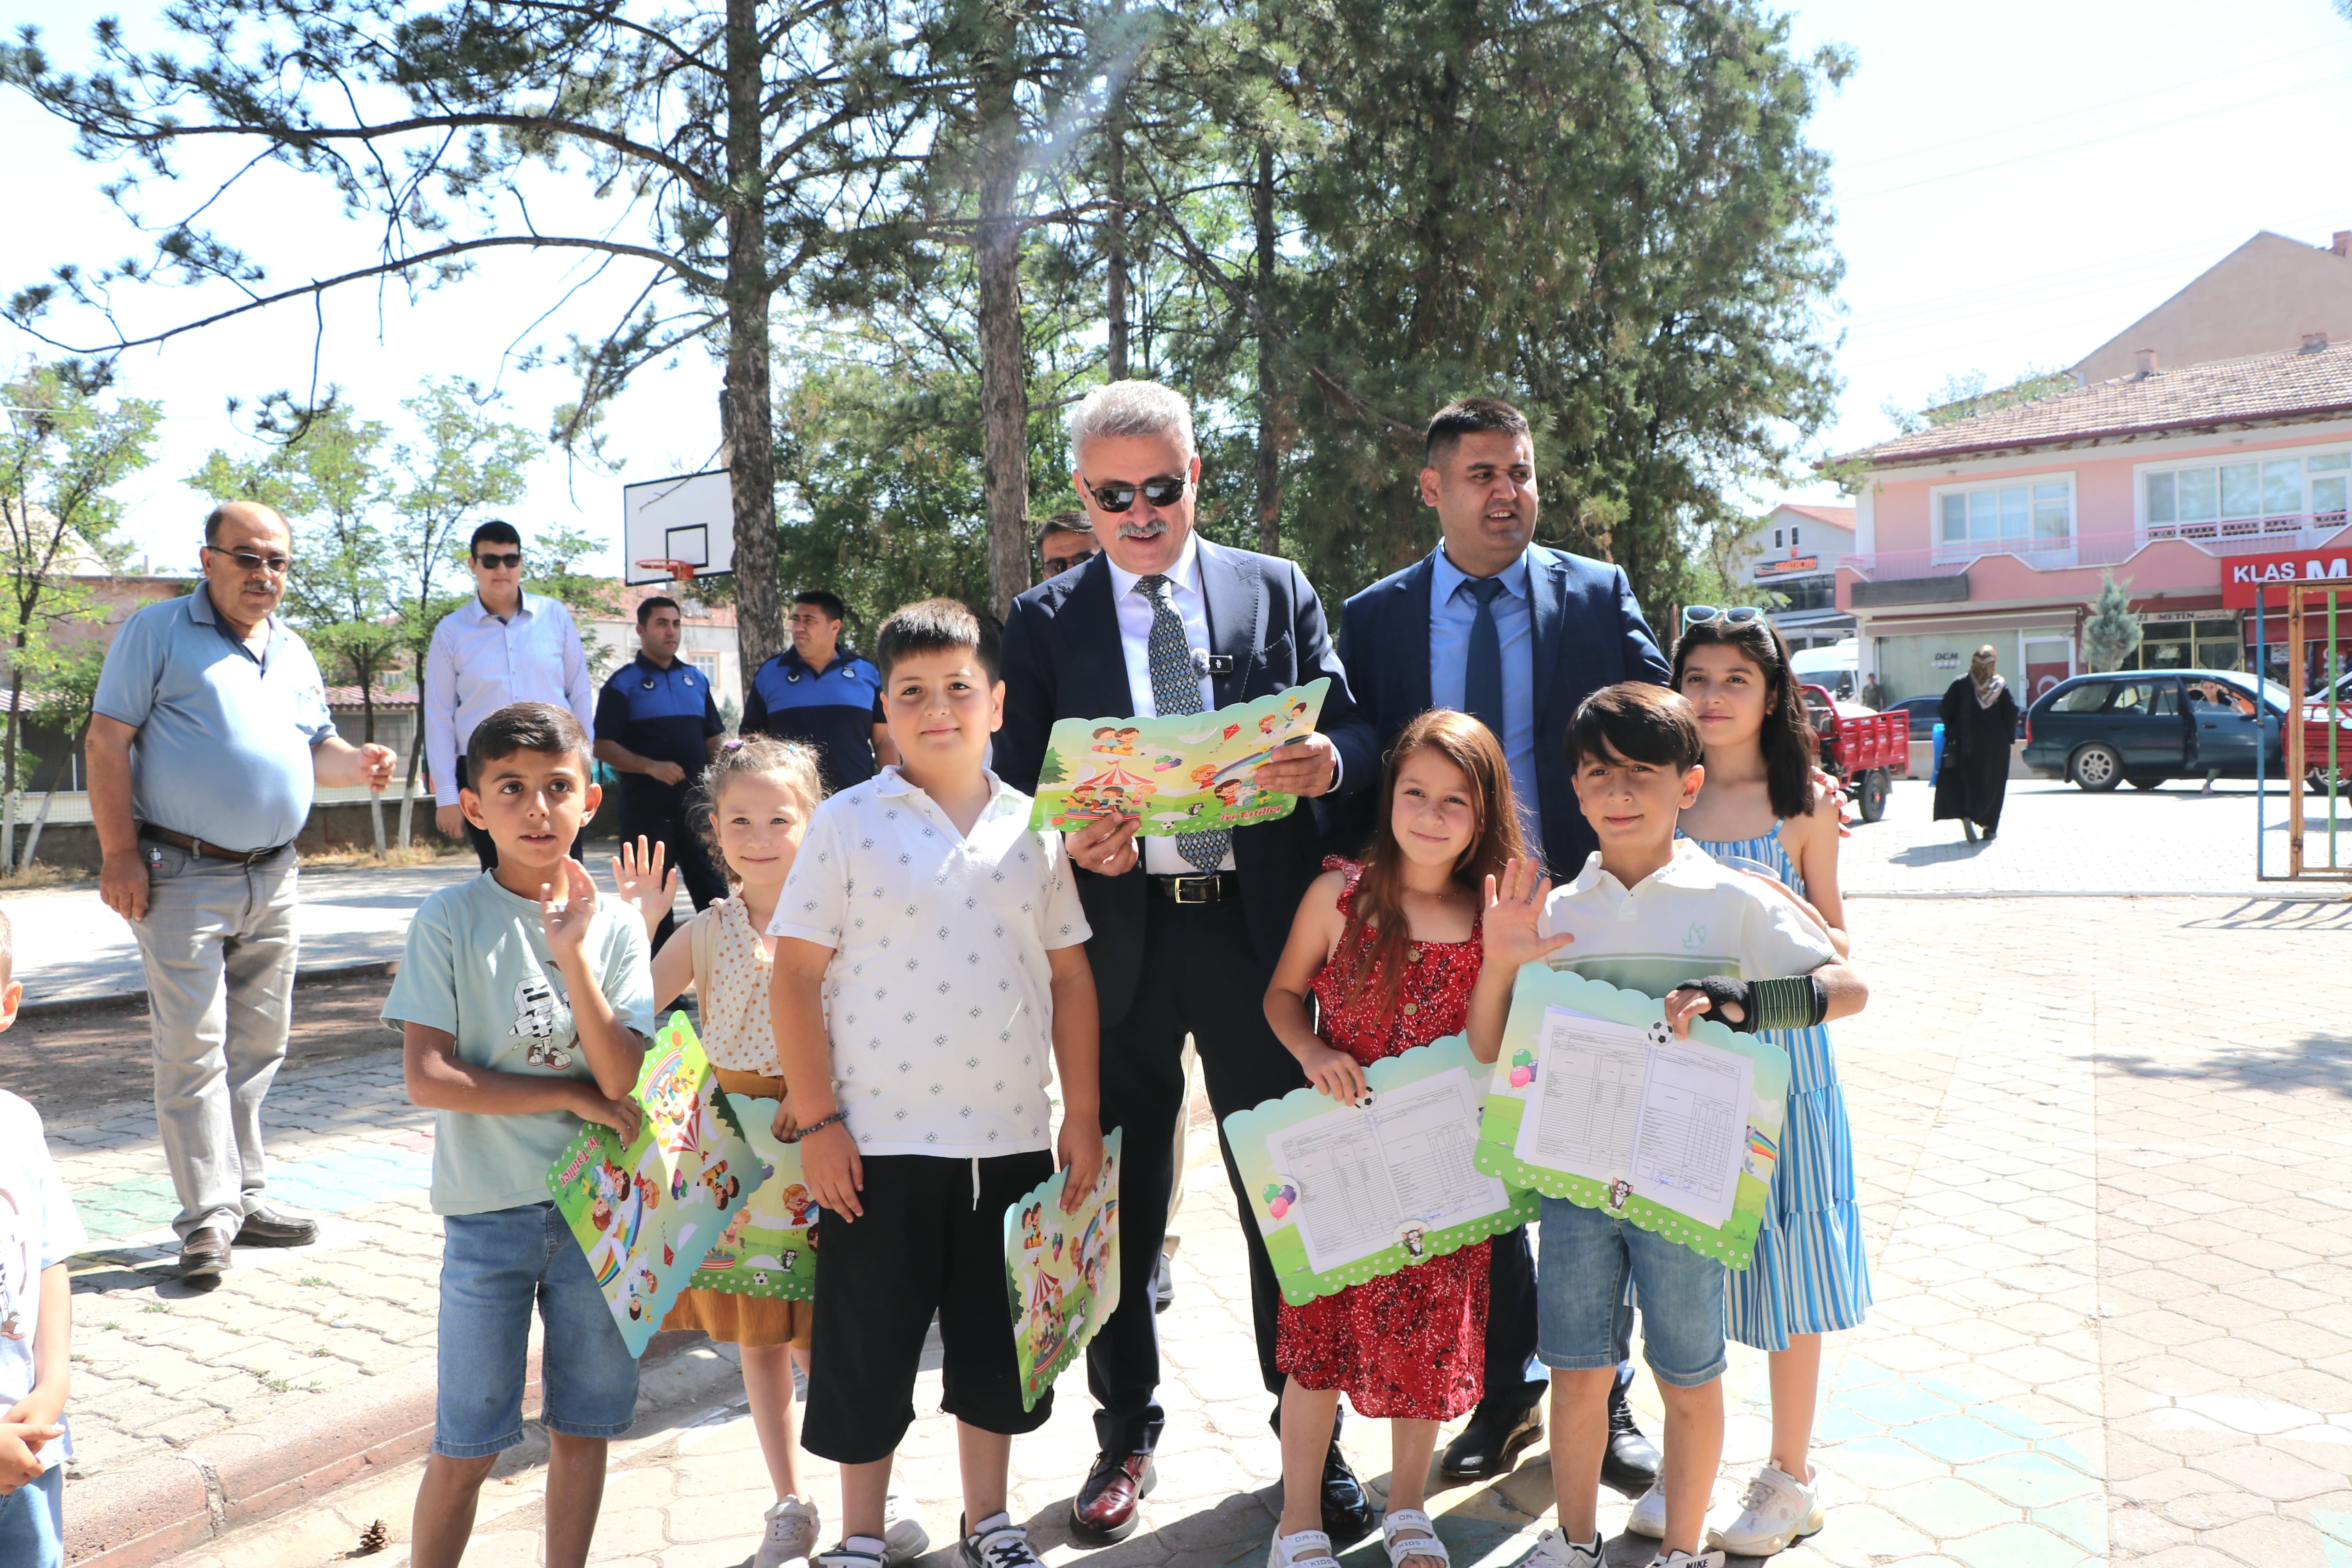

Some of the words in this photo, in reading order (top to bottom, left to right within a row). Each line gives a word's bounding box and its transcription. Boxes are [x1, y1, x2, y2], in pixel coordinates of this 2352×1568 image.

[2233, 562, 2296, 583] KLAS
[1239, 805, 1283, 819] Tatiller
[560, 1149, 591, 1188] Tatiller
[1685, 1559, 1708, 1568] NIKE
